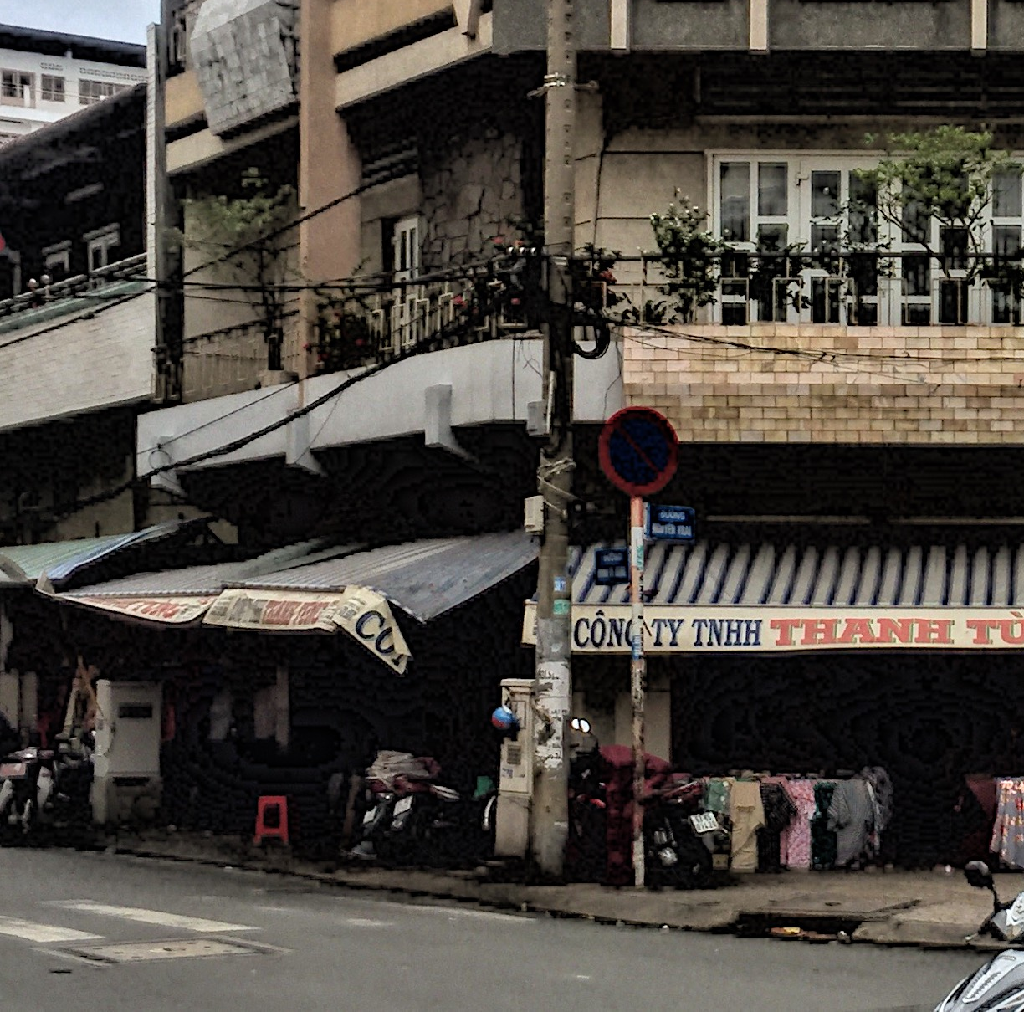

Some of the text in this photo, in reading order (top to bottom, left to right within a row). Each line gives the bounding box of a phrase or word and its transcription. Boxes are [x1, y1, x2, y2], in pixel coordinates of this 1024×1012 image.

[651, 618, 685, 646] TY
[691, 618, 763, 647] TNHH
[771, 617, 956, 647] THANH
